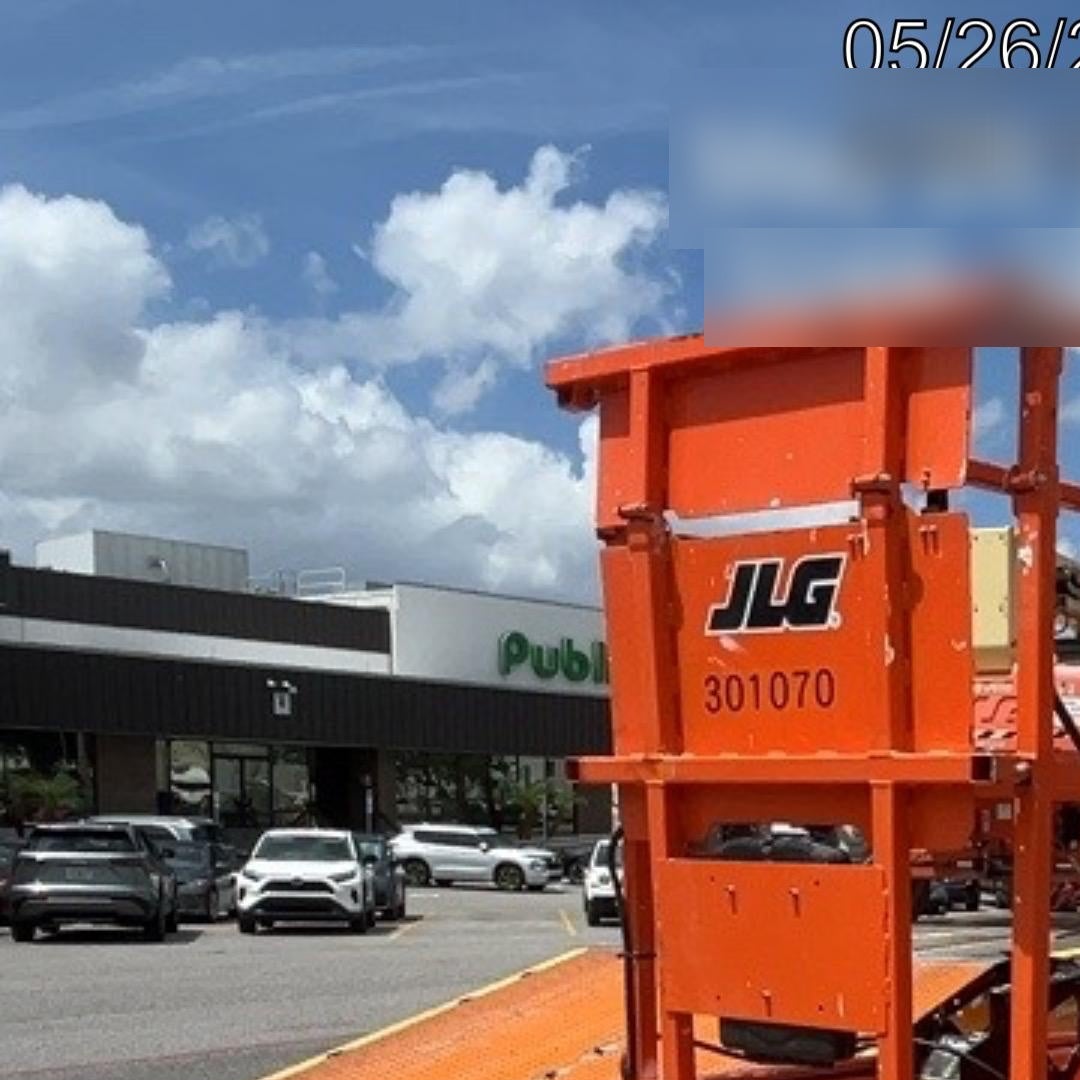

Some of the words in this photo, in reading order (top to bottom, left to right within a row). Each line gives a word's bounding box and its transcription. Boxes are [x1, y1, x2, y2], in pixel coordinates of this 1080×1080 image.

[707, 553, 848, 637] JLG
[498, 631, 609, 684] Publ
[705, 668, 836, 714] 301070
